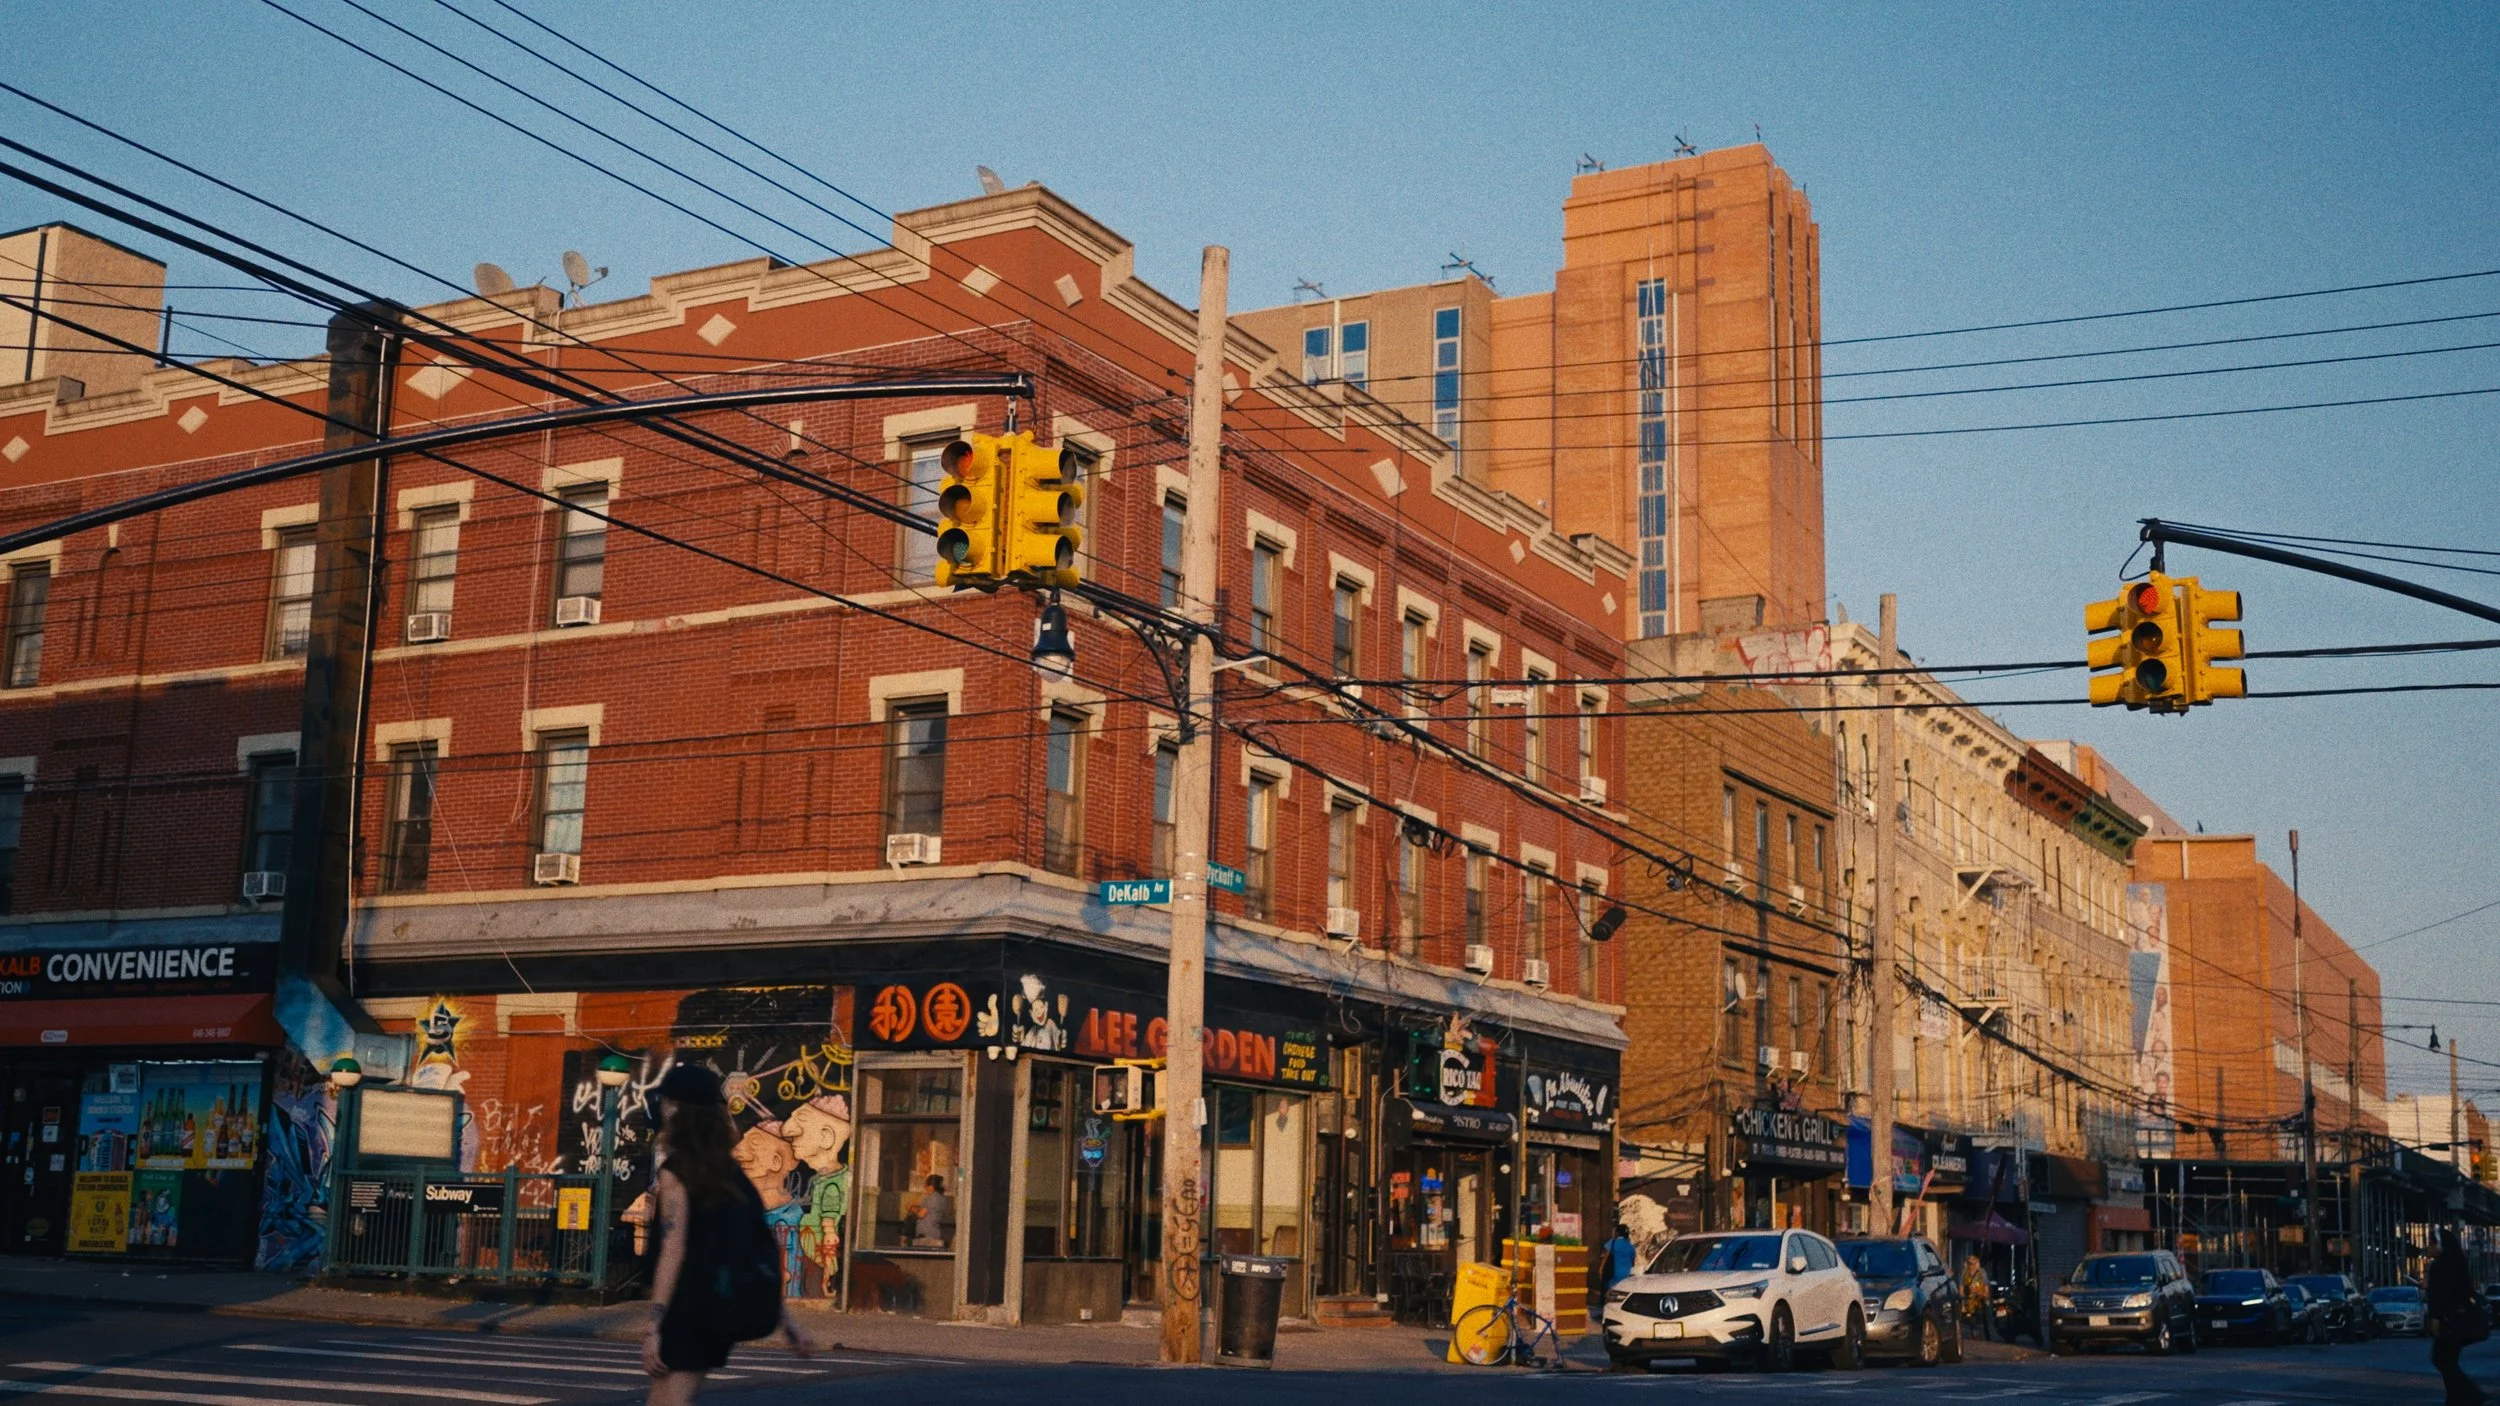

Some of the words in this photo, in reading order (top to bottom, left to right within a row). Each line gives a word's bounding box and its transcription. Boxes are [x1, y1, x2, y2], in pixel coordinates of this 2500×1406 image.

[1108, 884, 1150, 902] DeKalb
[1154, 882, 1164, 893] Av
[47, 947, 236, 982] CONVENIENCE
[1086, 1008, 1138, 1059] LEE
[1145, 1016, 1277, 1080] GRDEN
[1282, 1042, 1317, 1060] CHINESE
[1288, 1057, 1306, 1070] FOOD
[1281, 1068, 1299, 1081] TAKE
[1301, 1069, 1317, 1083] OUT
[1443, 1067, 1465, 1089] RICO
[1741, 1109, 1792, 1141] CHICKEN
[1794, 1123, 1801, 1142] &
[1802, 1117, 1833, 1145] GRILL
[425, 1185, 473, 1204] Subway
